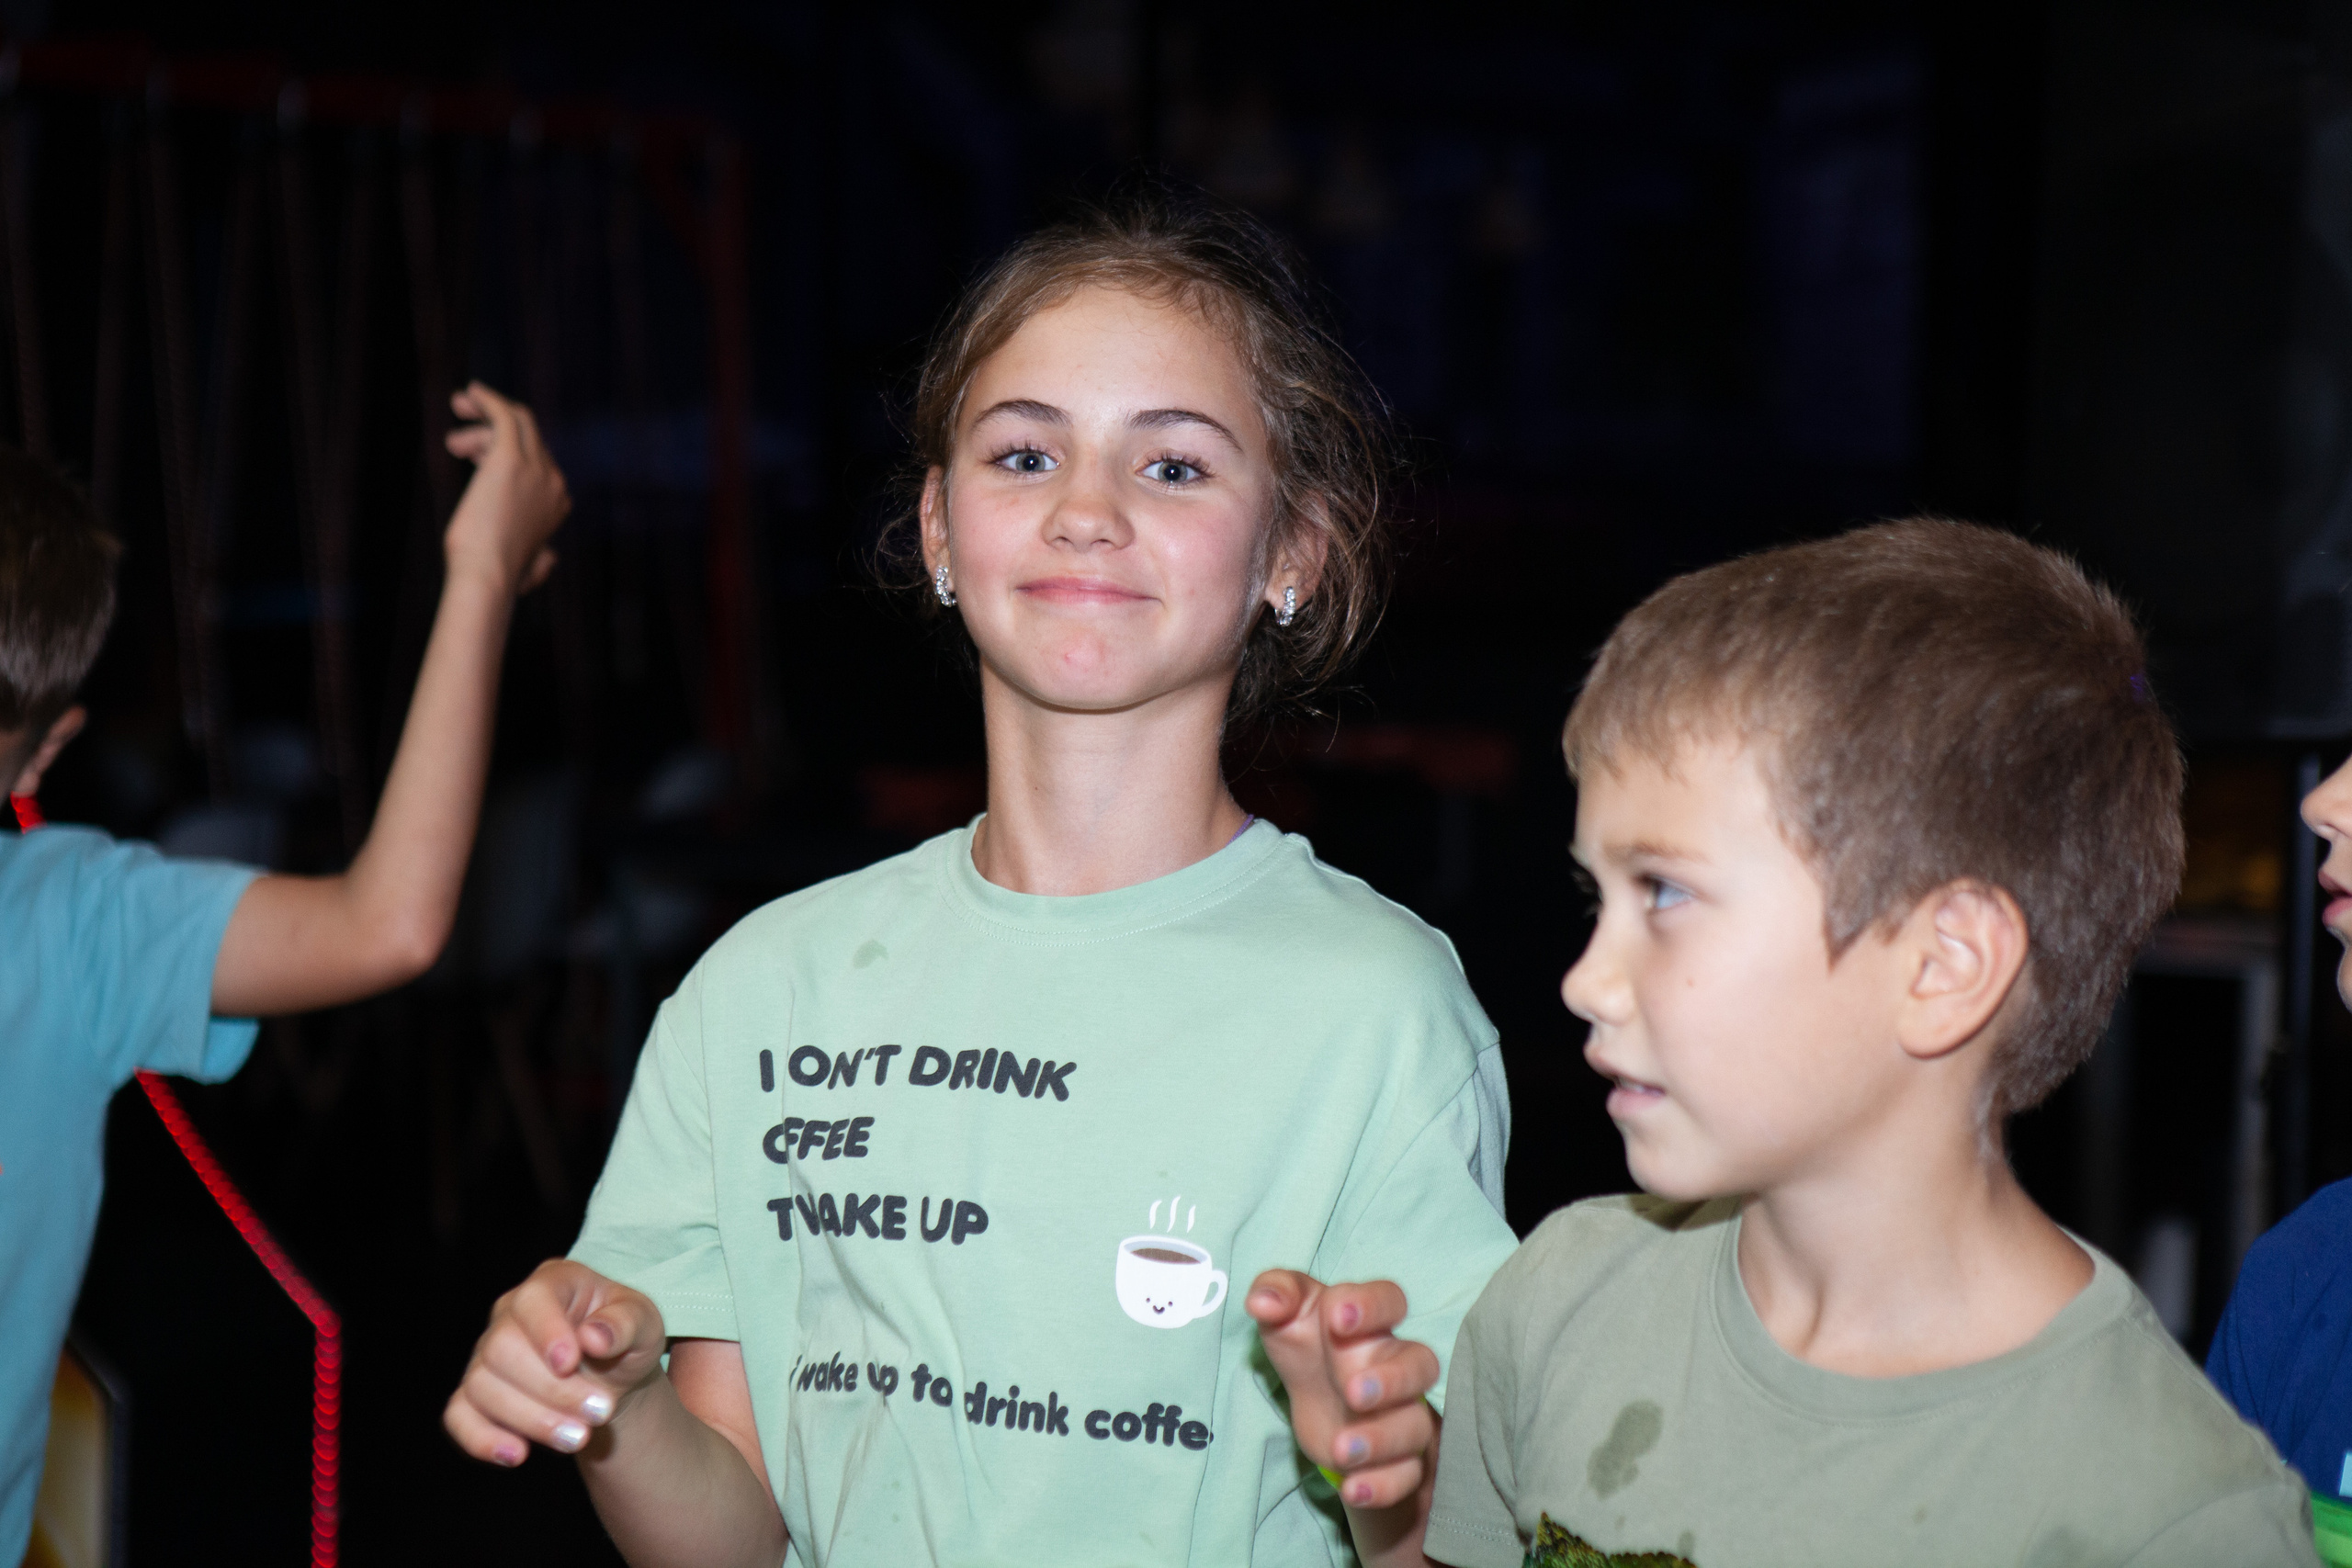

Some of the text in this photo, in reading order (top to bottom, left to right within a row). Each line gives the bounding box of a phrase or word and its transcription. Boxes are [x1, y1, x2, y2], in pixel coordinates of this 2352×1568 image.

[759, 1044, 1078, 1102] I ON'T DRINK
[920, 1196, 989, 1246] UP
[910, 1363, 954, 1407] to
[964, 1381, 1070, 1437] drink
[1084, 1402, 1215, 1451] coffe
